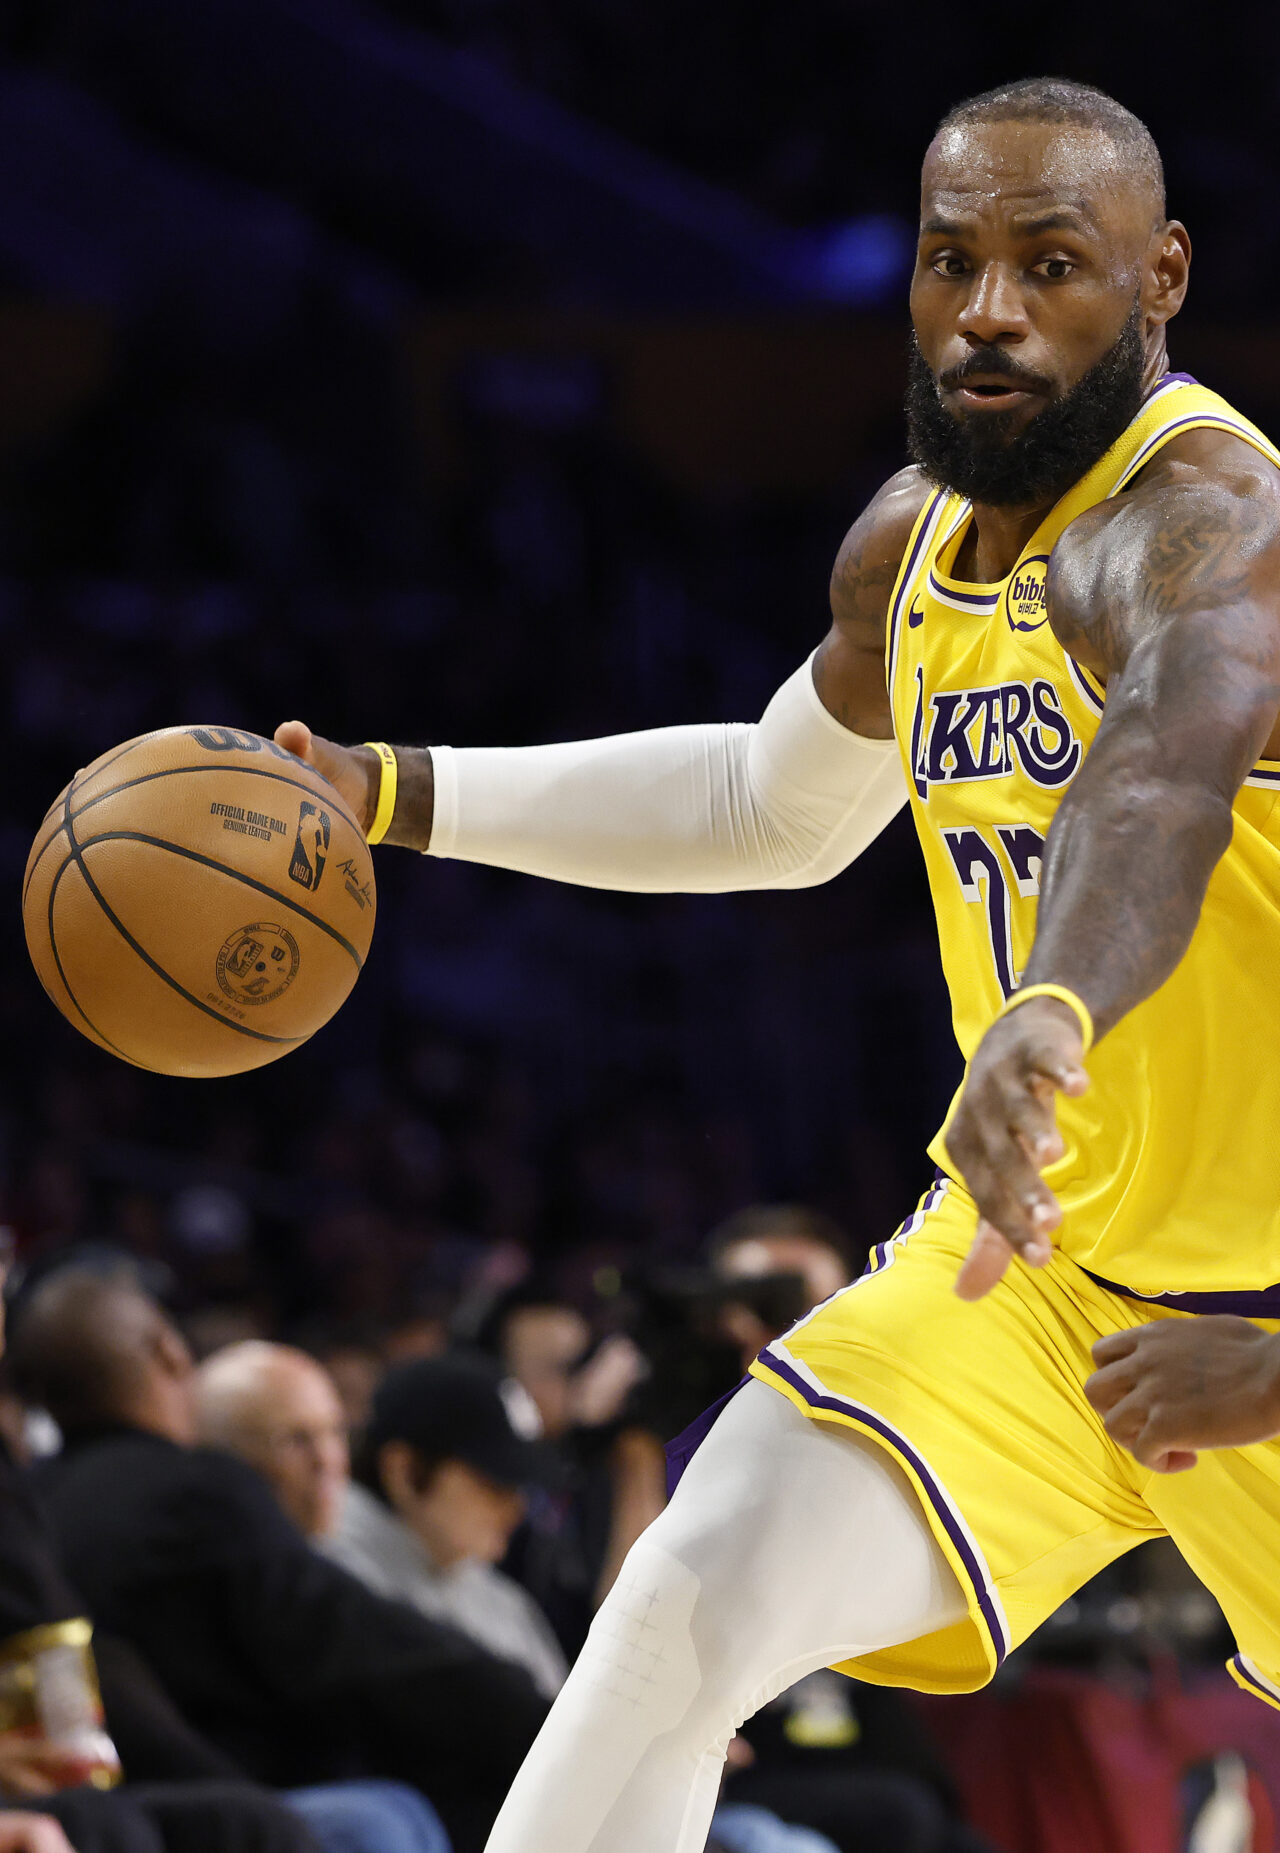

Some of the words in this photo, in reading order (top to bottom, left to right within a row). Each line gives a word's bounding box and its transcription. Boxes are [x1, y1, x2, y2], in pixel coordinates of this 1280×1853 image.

[911, 662, 1082, 804] LKERS
[210, 802, 245, 820] OFFICIAL
[247, 811, 269, 828] GAME
[269, 818, 287, 835] BALL
[223, 819, 248, 835] GENUINE
[248, 825, 272, 841] LEATHER
[292, 861, 310, 883] NBA
